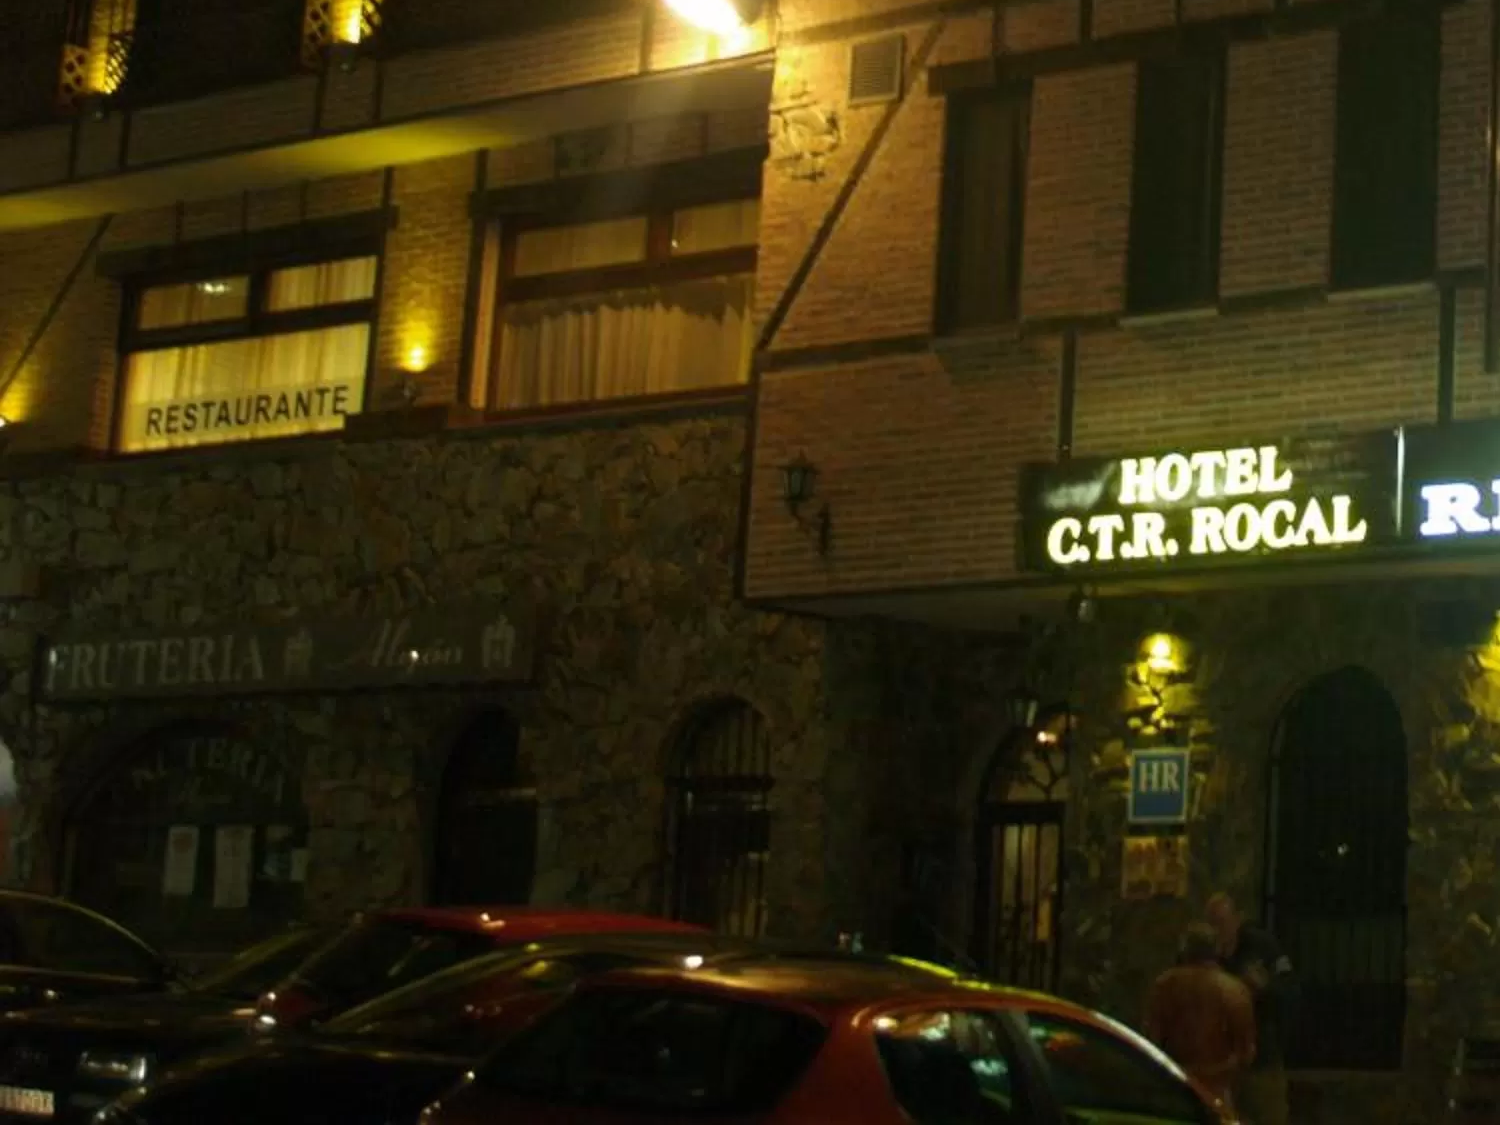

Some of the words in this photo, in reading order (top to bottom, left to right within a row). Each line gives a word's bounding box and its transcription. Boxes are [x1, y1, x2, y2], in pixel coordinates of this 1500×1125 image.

[146, 385, 349, 436] RESTAURANTE
[1117, 445, 1293, 505] HOTEL
[1047, 516, 1179, 564] C.T.R.
[1189, 495, 1368, 555] ROCAL
[1138, 761, 1181, 794] HR
